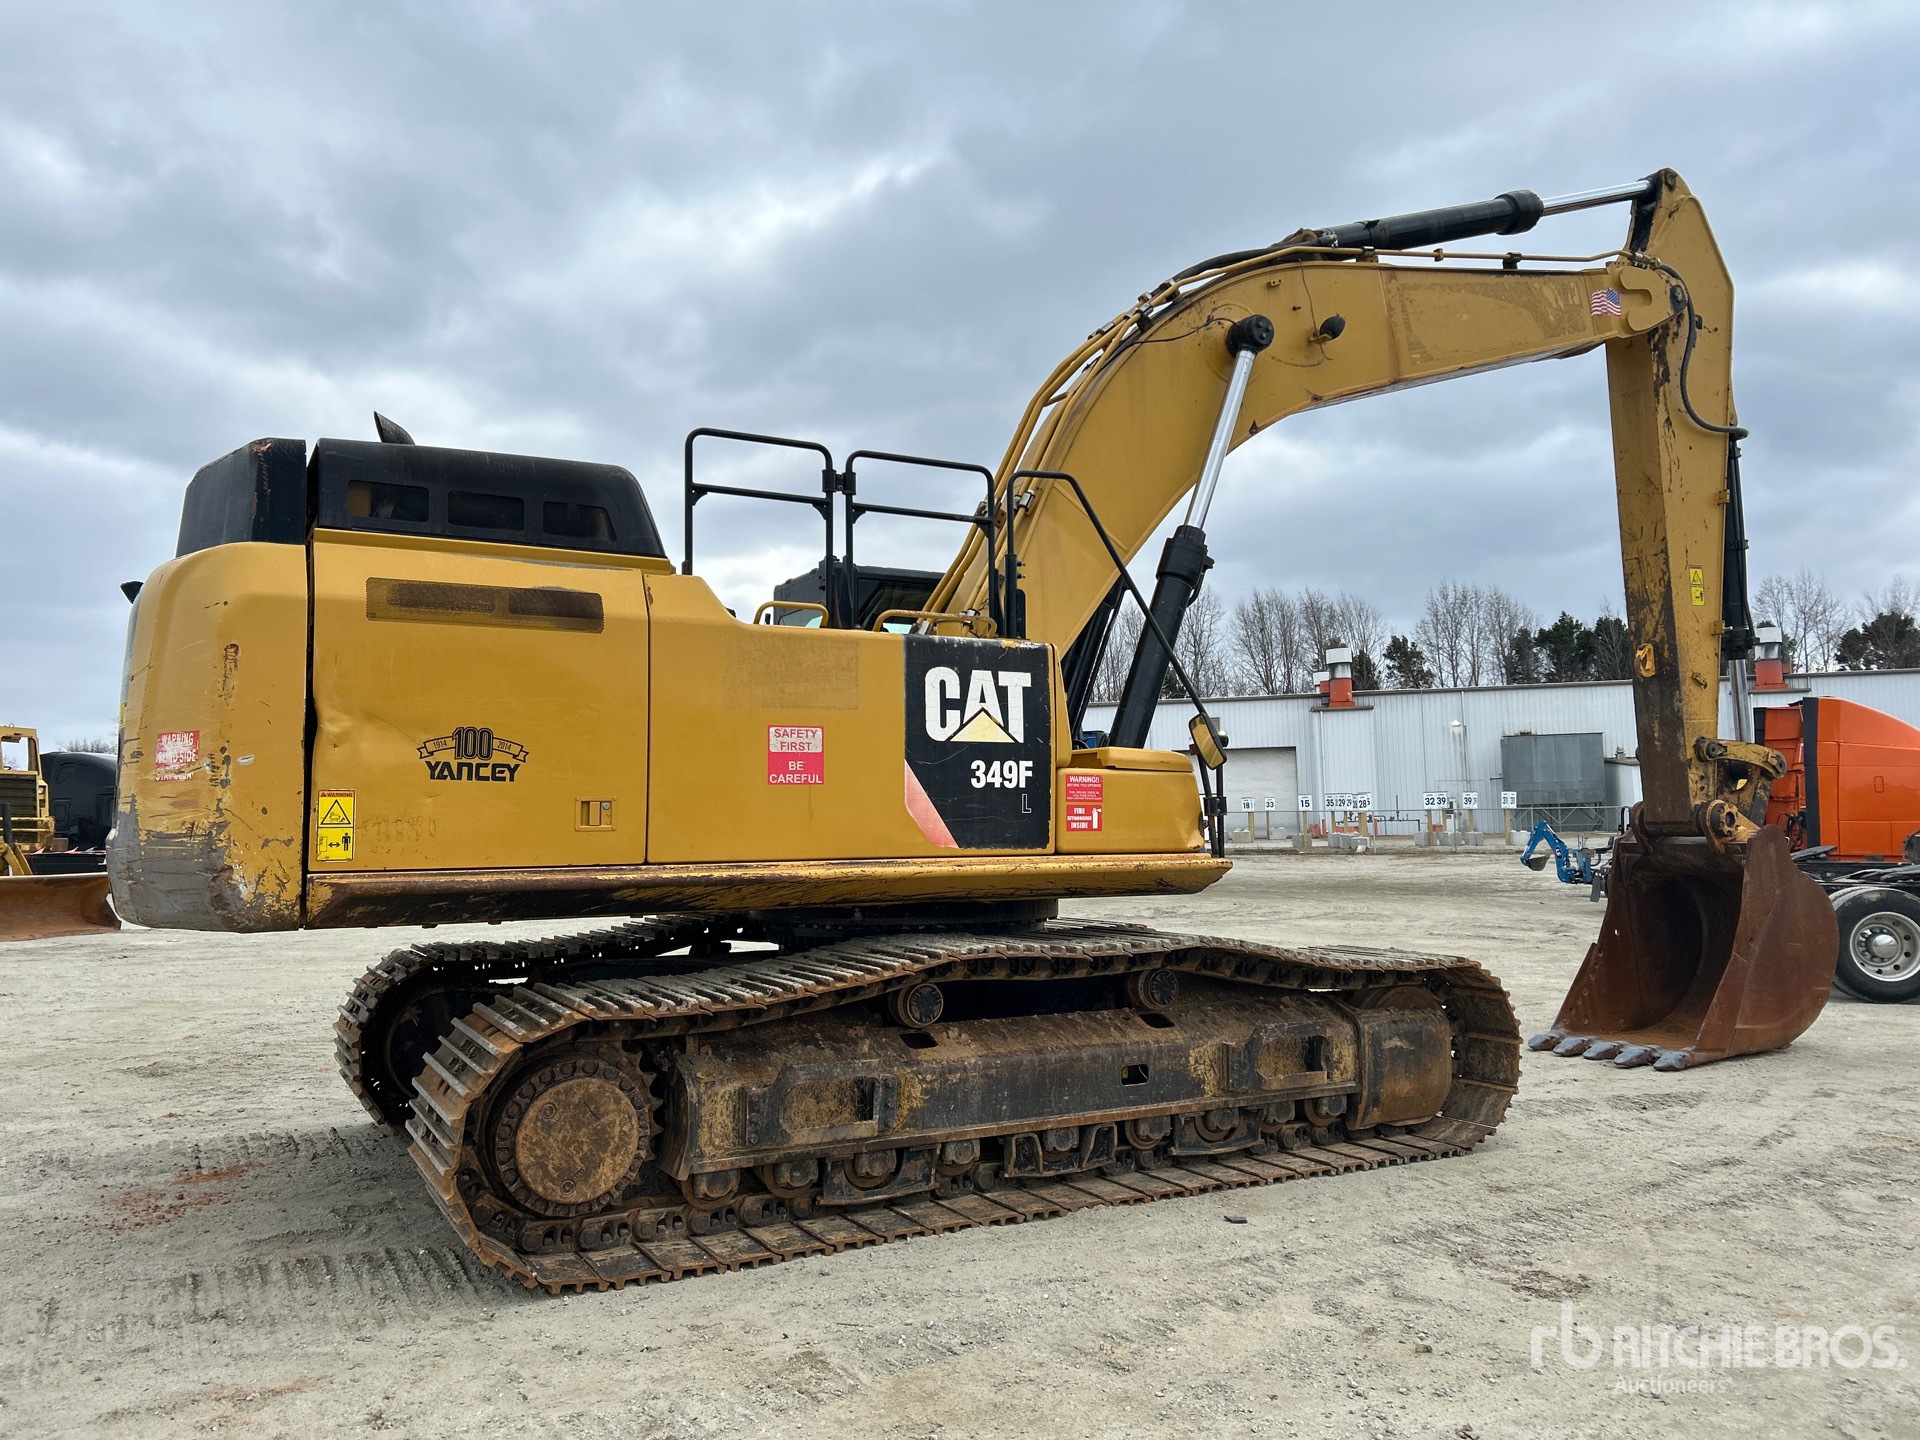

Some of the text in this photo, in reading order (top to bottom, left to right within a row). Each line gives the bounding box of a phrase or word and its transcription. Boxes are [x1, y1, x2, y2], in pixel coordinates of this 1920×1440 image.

[924, 666, 1032, 744] CAT
[774, 728, 818, 738] SAFETY
[161, 732, 194, 746] WARNING
[433, 727, 512, 760] 1914 100 2014
[780, 741, 812, 751] FIRST
[424, 760, 521, 782] YANCEY
[788, 761, 804, 771] BE
[769, 774, 823, 784] CAREFUL
[970, 760, 1034, 789] 349F
[1021, 793, 1032, 814] L
[1300, 799, 1310, 808] 15
[1326, 799, 1335, 807] 35
[1338, 799, 1346, 807] 29
[1358, 800, 1367, 808] 28
[1424, 797, 1436, 806] 32
[1436, 797, 1446, 805] 39
[1463, 797, 1473, 805] 39
[1073, 807, 1086, 815] FIRE
[1070, 821, 1089, 829] INSIDE
